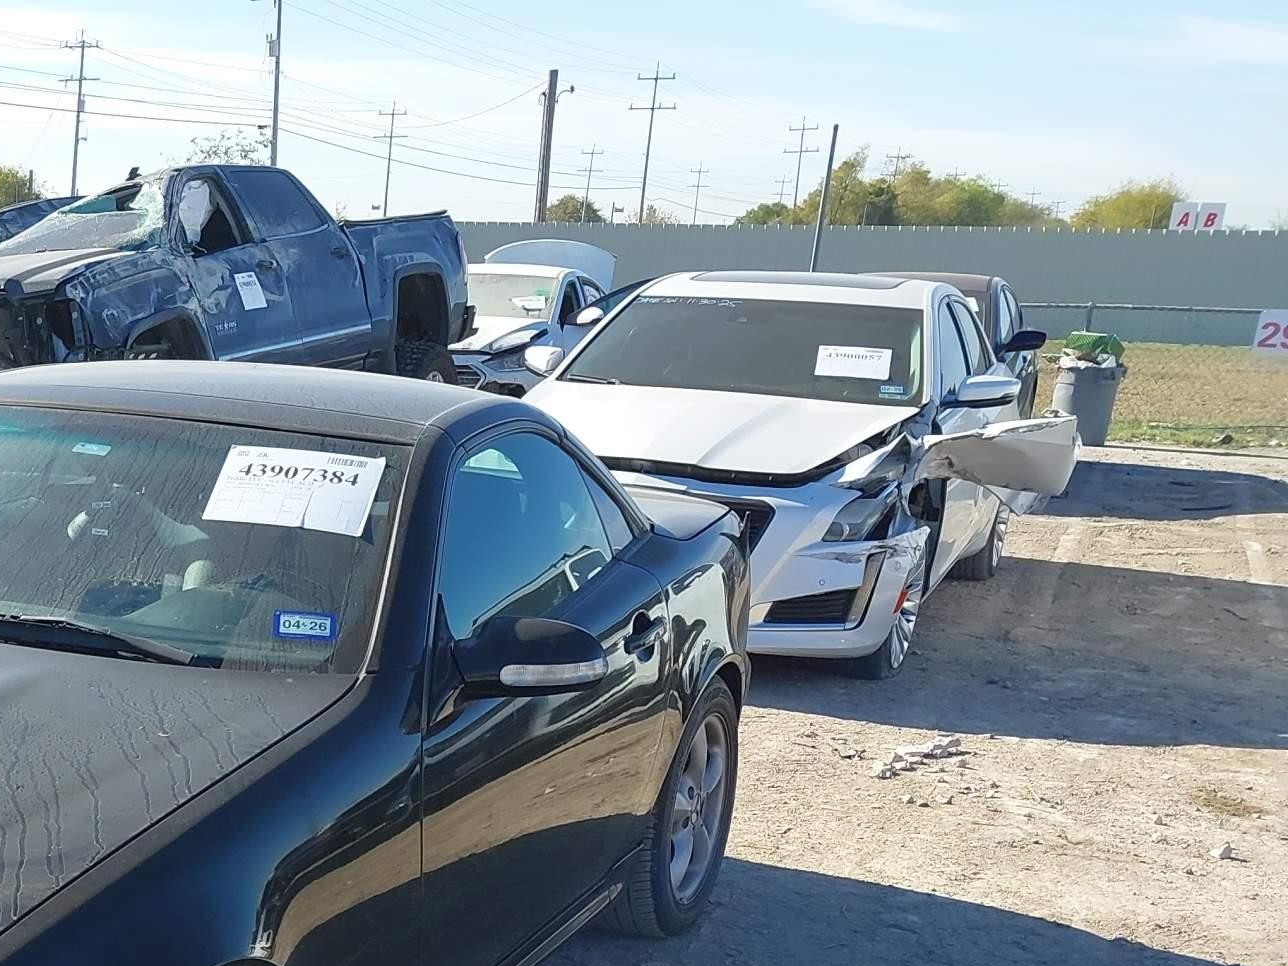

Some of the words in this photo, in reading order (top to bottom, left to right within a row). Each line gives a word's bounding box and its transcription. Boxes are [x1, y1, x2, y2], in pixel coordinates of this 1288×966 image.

[1176, 211, 1190, 227] A
[1203, 212, 1218, 228] B
[238, 462, 360, 487] 43907384
[282, 619, 301, 630] 04
[309, 620, 328, 632] 26
